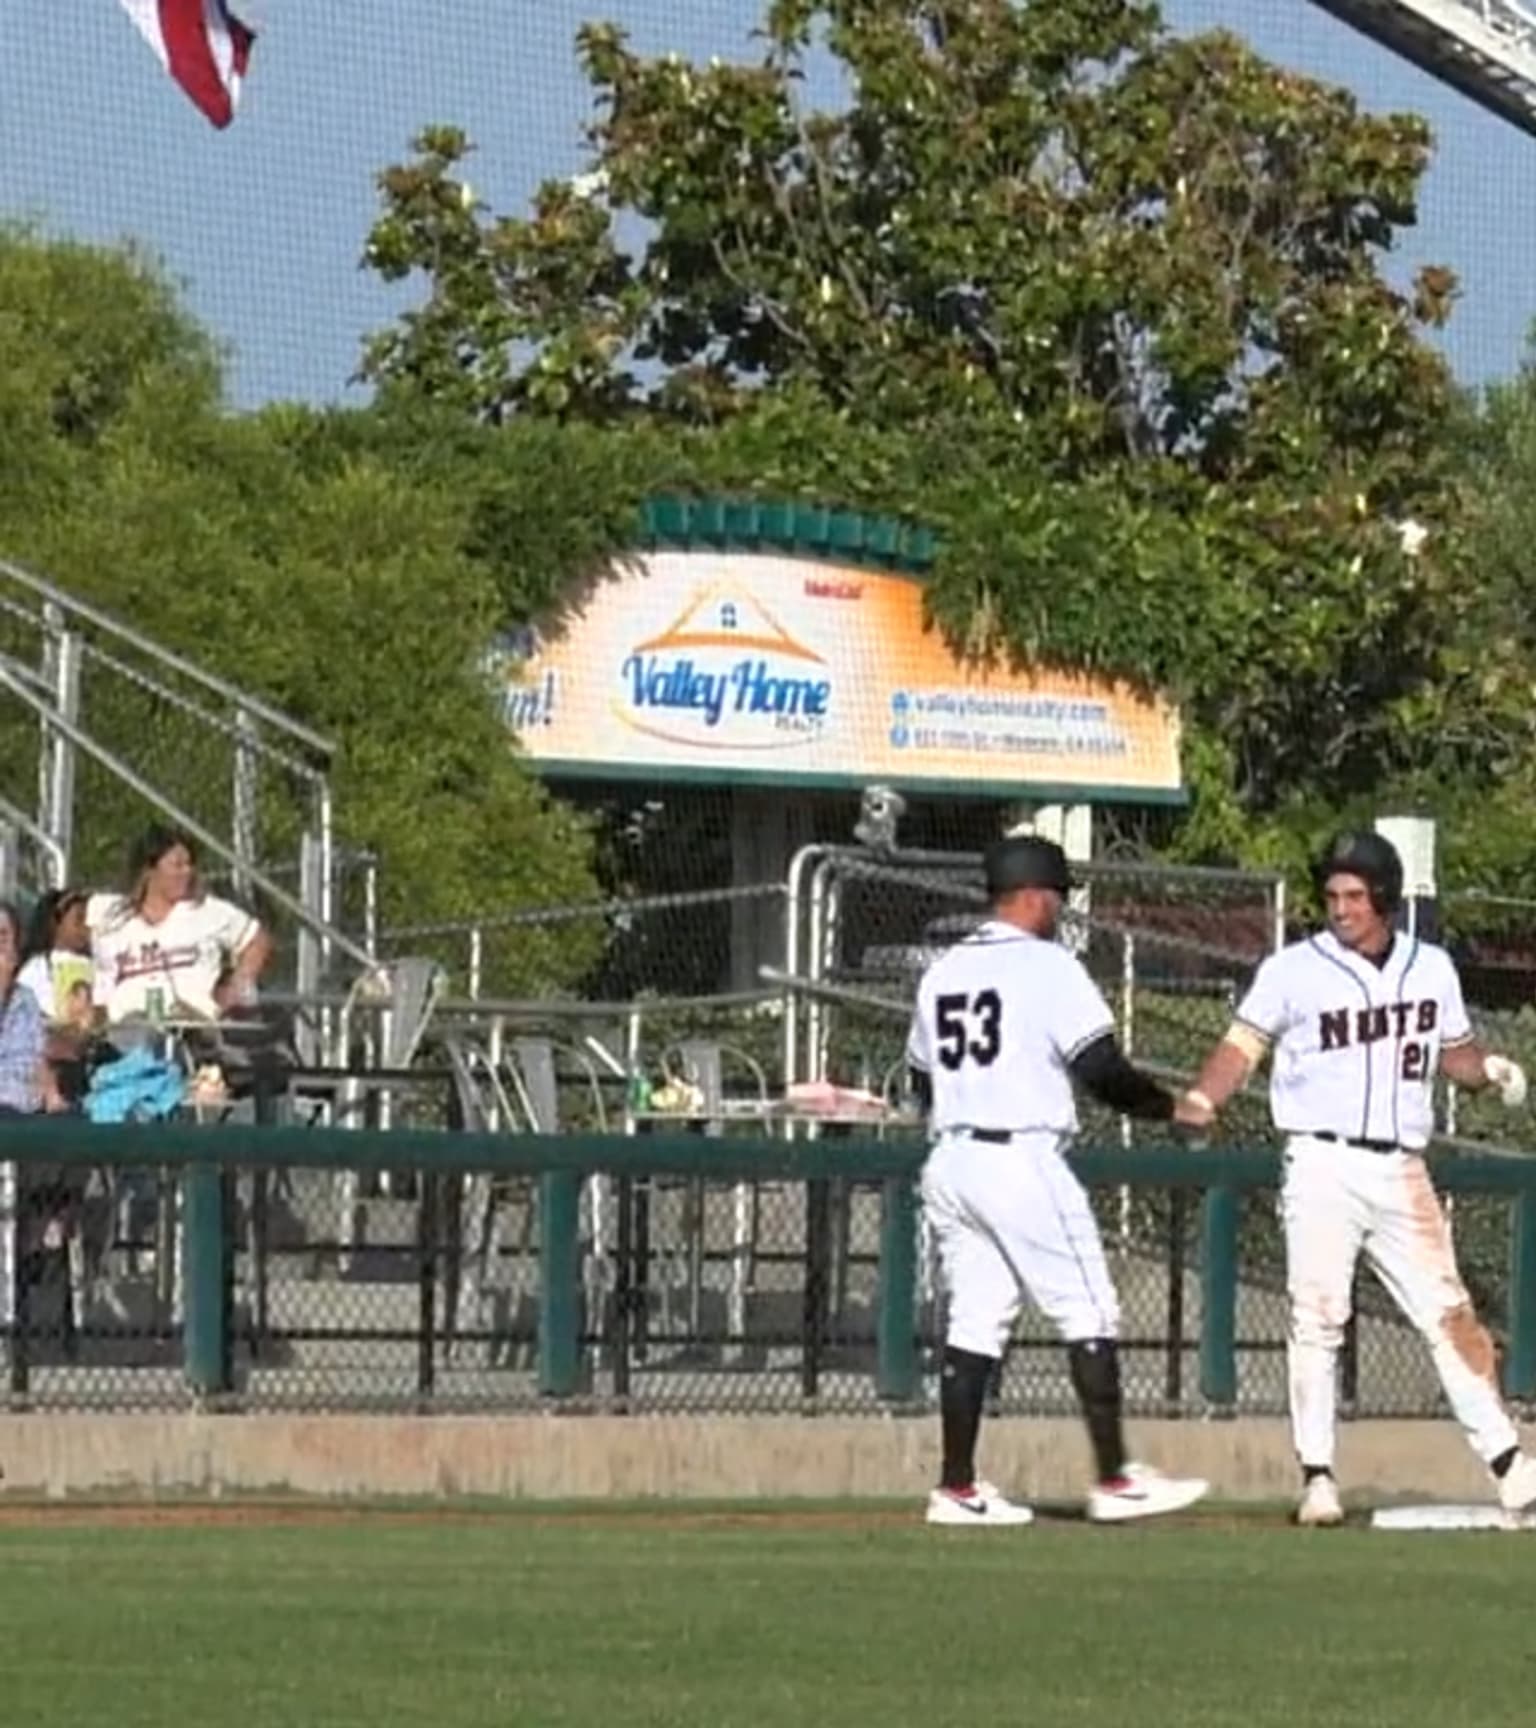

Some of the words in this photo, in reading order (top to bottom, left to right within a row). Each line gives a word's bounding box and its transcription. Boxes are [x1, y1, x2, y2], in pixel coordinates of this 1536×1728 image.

[621, 654, 727, 727] Valley
[730, 660, 832, 715] Home
[936, 987, 1002, 1071] 53
[1319, 998, 1438, 1053] NUTS
[1401, 1042, 1430, 1081] 21
